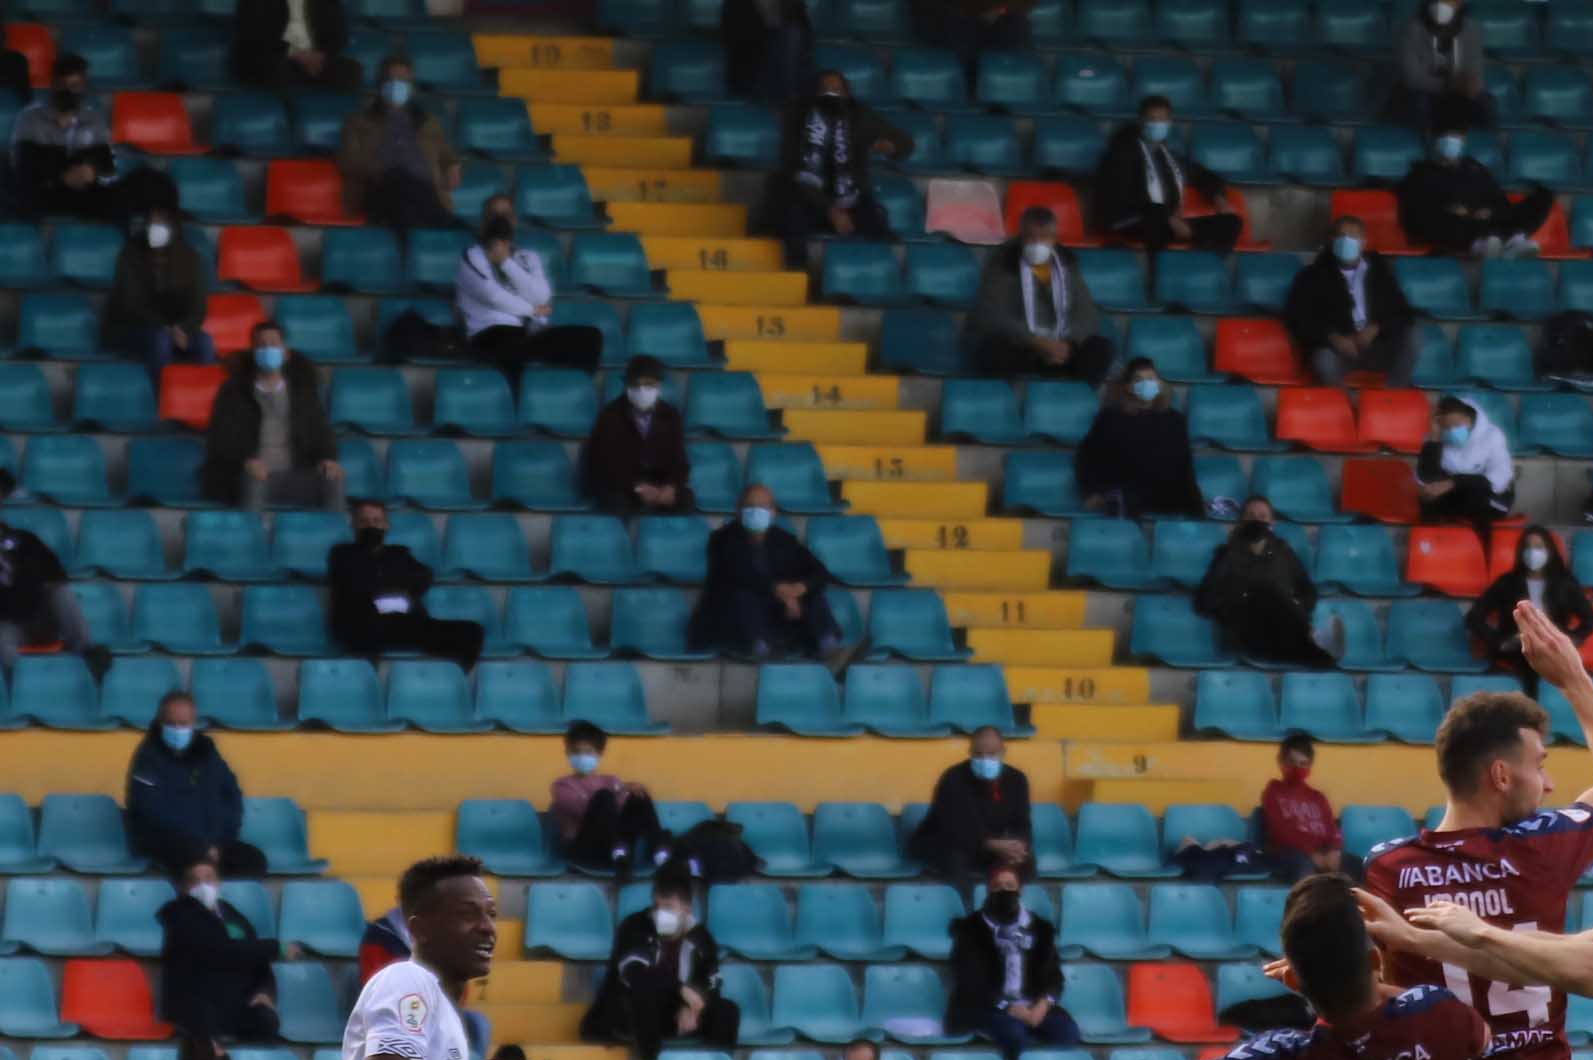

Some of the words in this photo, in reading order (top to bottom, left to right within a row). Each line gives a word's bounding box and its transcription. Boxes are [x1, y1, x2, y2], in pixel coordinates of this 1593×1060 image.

[937, 525, 968, 548] 12
[1002, 601, 1025, 623] 11
[1066, 677, 1095, 700] 10
[1133, 754, 1147, 773] 9
